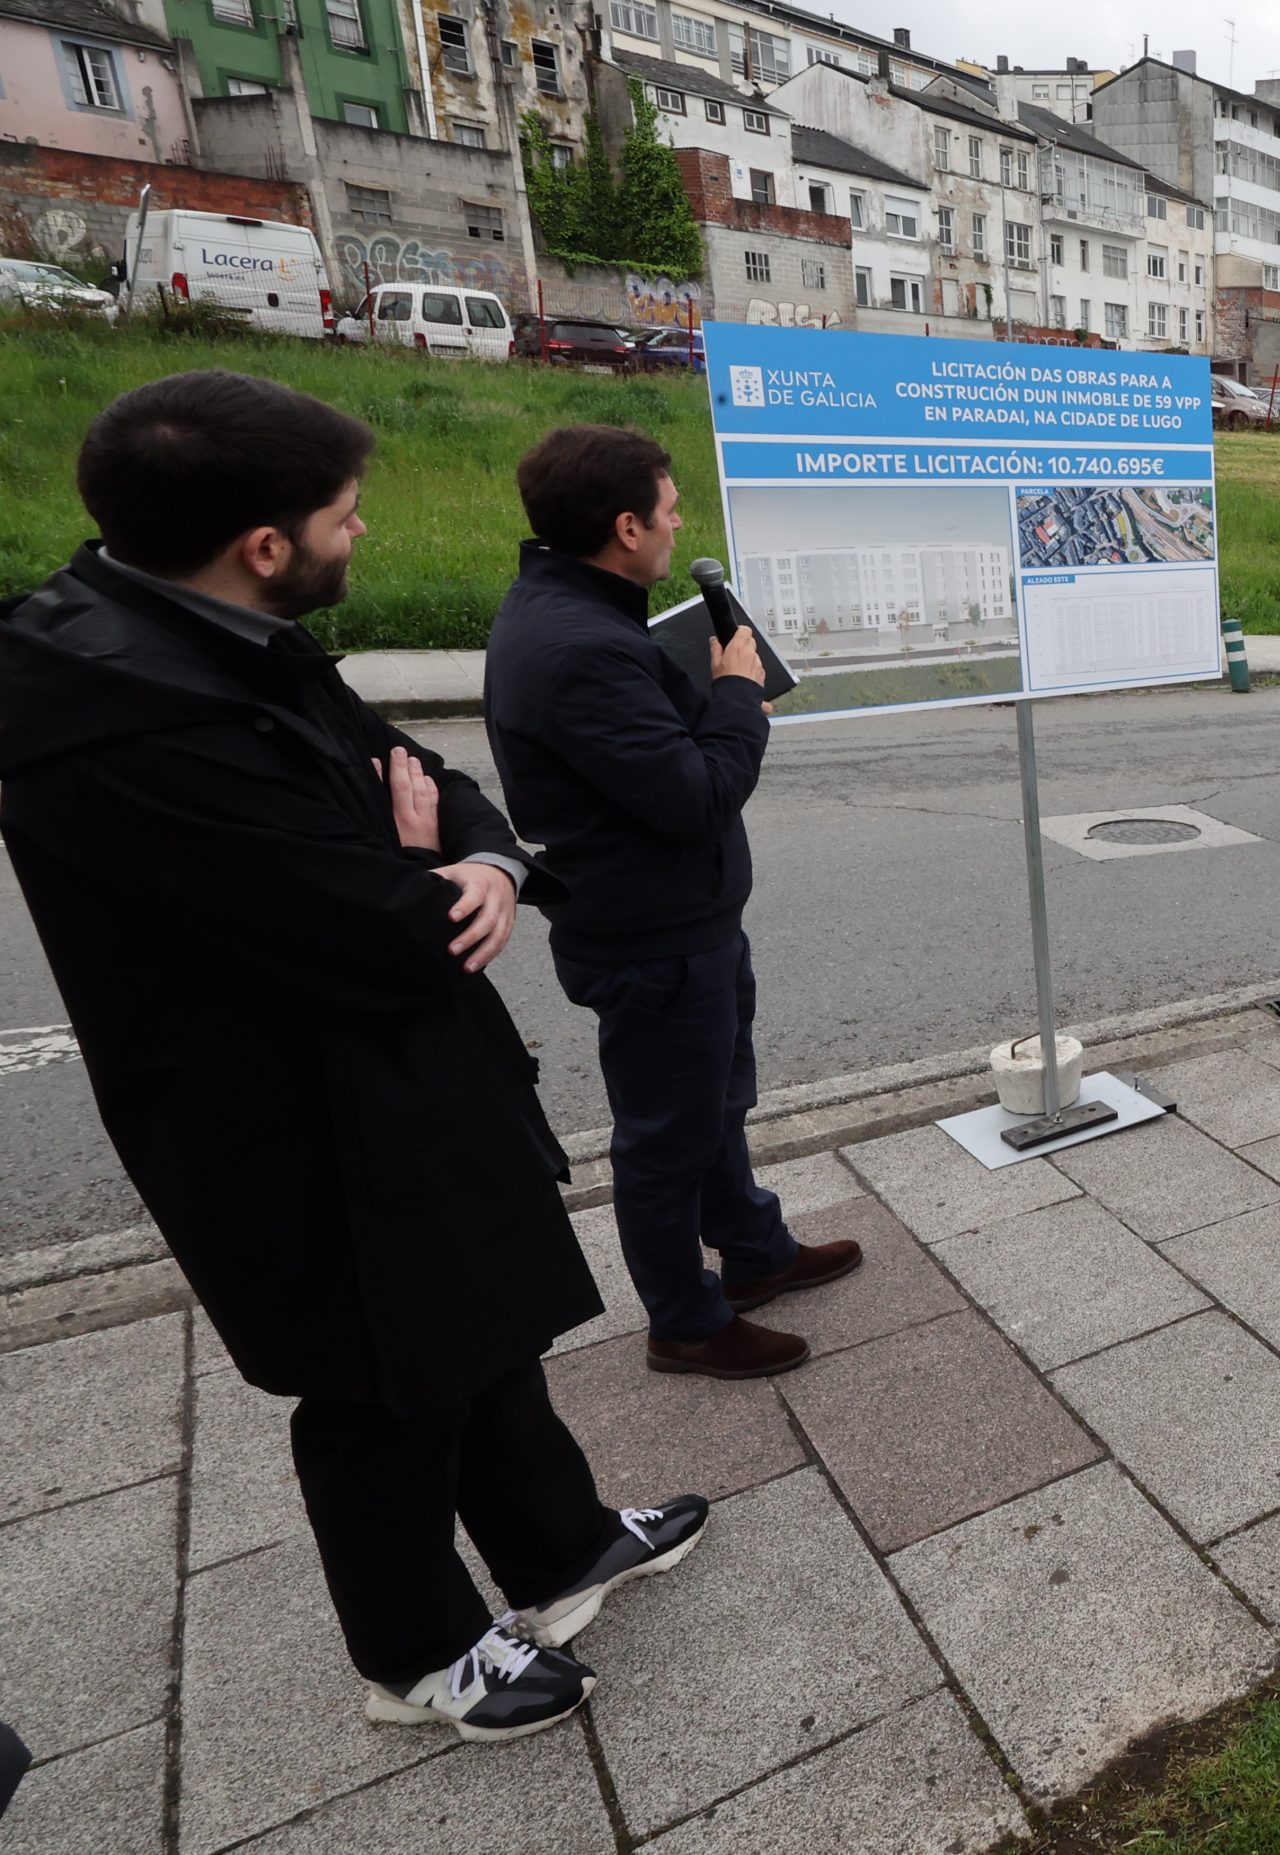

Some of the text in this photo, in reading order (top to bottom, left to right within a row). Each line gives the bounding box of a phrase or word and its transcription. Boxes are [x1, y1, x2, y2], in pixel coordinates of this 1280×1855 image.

[201, 247, 273, 271] Lacera
[767, 369, 836, 388] XUNTA
[931, 361, 1172, 389] LICITACIÓN DAS OBRAS PARA A
[768, 389, 878, 409] DE GALICIA
[895, 382, 1201, 411] CONSTRUCIÓN DUN INMOBLE DE 59 VPP
[924, 405, 1182, 429] EN PARADAI, NA CIDADE DE LUGO
[795, 450, 1164, 475] IMPORTE LICITACIÓN: 10.740.695€
